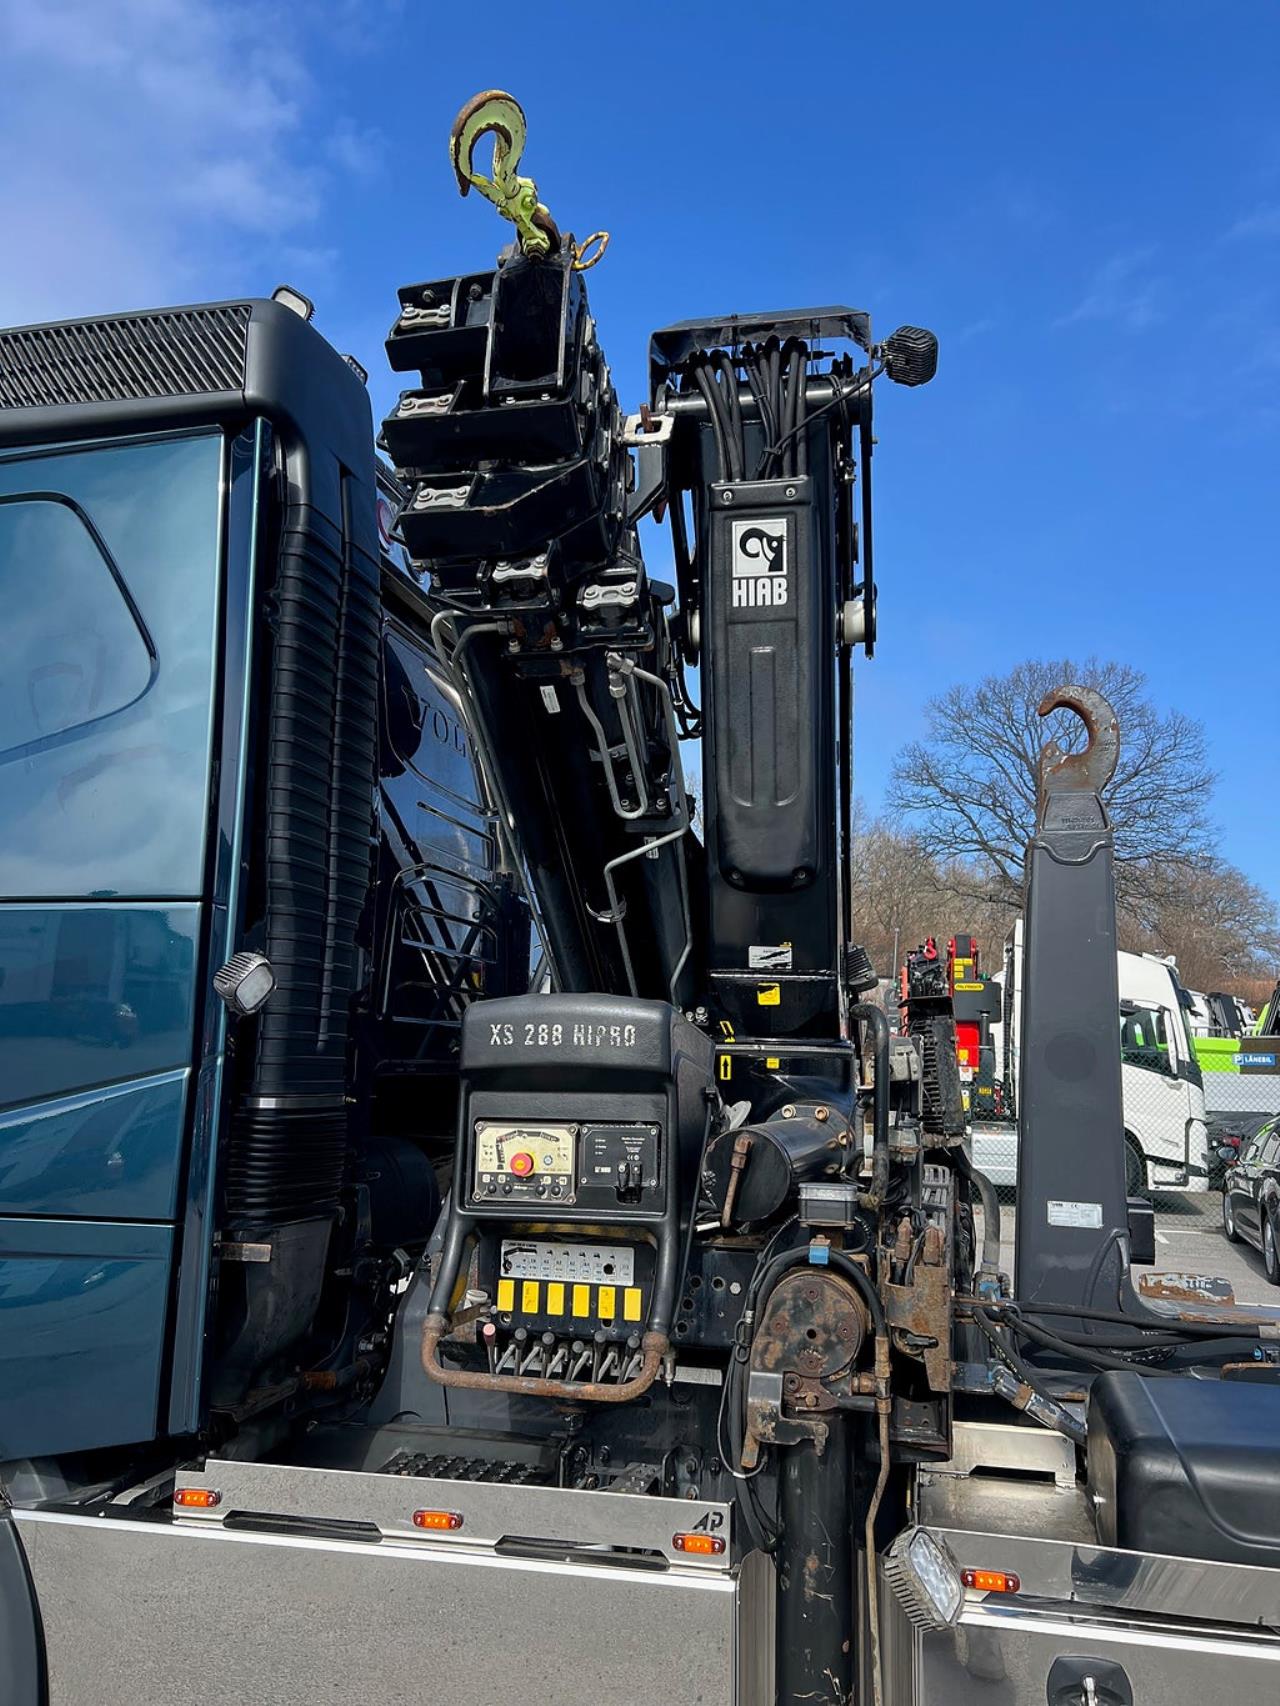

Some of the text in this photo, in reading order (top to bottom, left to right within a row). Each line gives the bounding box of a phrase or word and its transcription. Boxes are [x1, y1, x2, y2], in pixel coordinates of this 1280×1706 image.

[732, 578, 788, 607] HIAB
[489, 1023, 636, 1046] XS 288 HIPRO
[692, 1511, 724, 1531] AP
